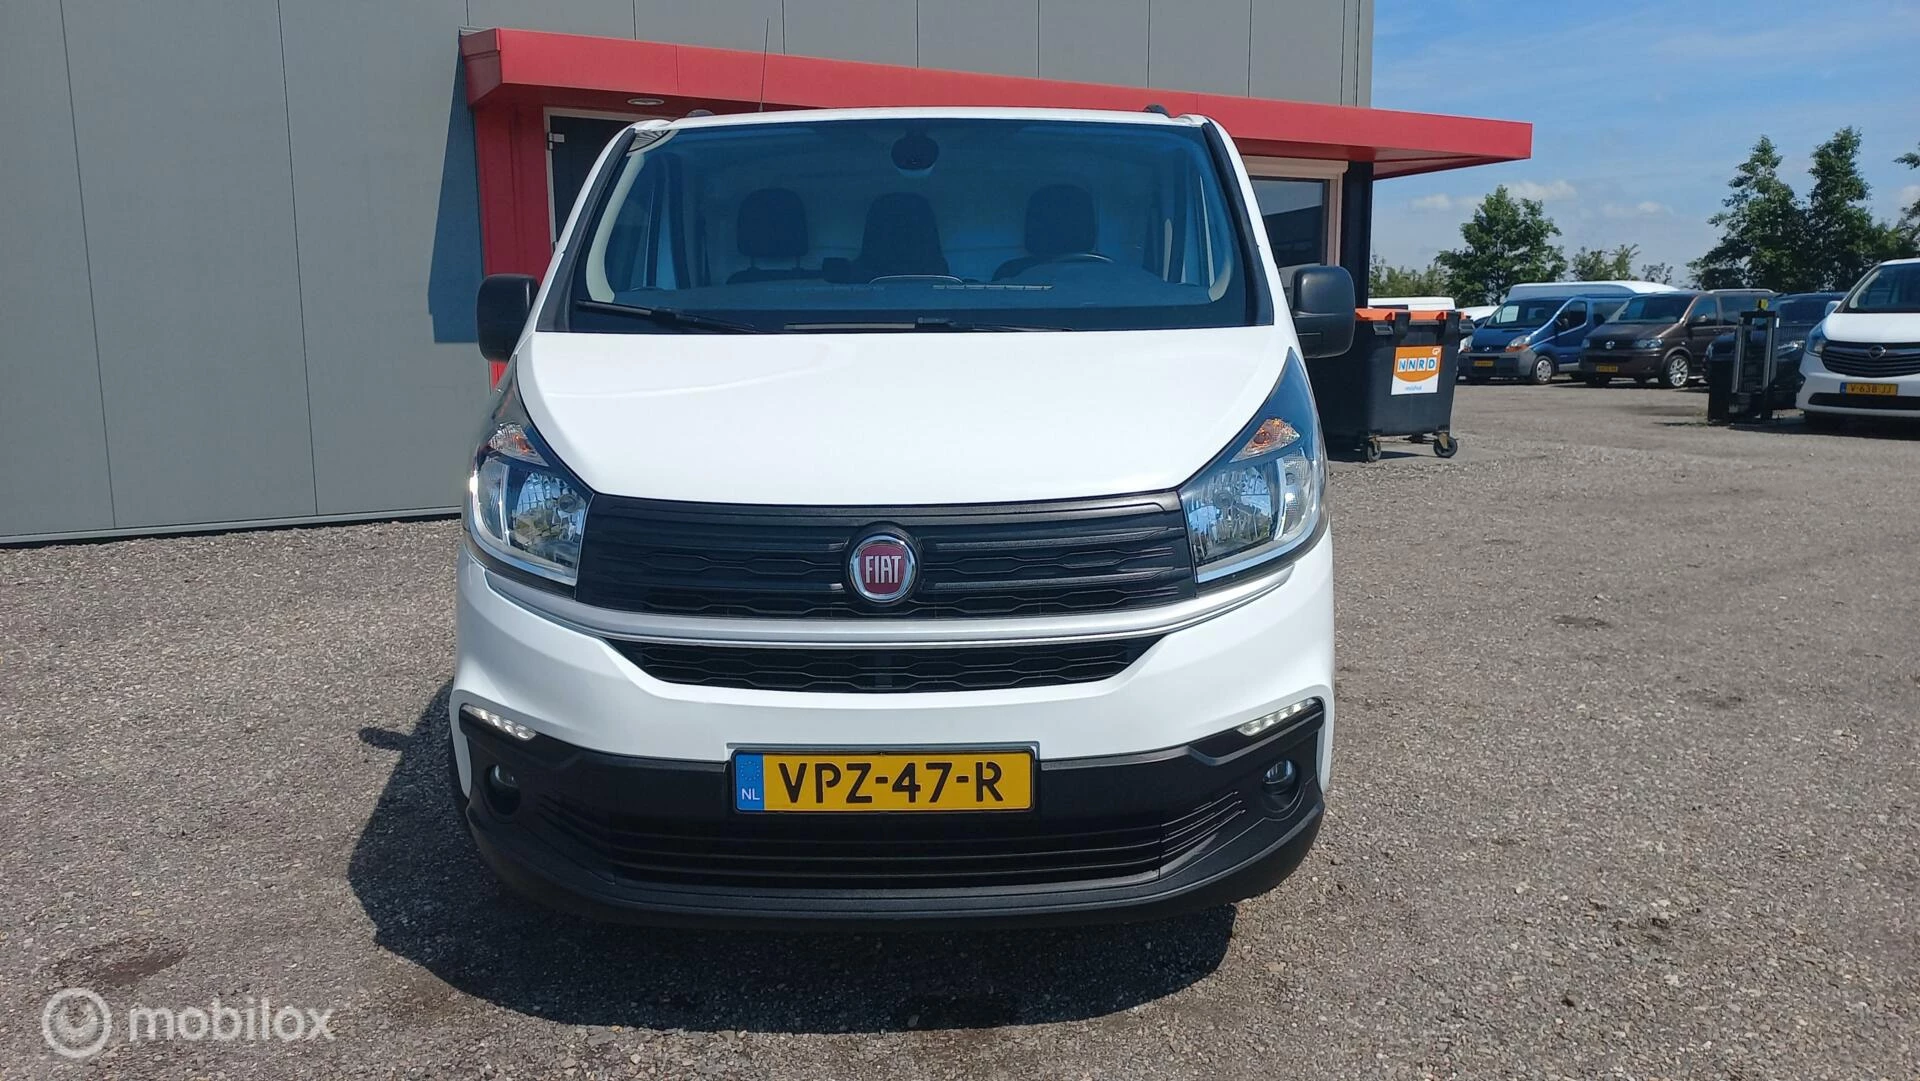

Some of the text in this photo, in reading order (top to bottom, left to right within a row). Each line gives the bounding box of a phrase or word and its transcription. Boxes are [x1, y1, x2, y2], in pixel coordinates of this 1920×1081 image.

[1398, 358, 1436, 370] NNRD
[865, 555, 902, 584] FIAT
[778, 762, 1004, 804] VPZ-47-R
[741, 788, 760, 800] NL
